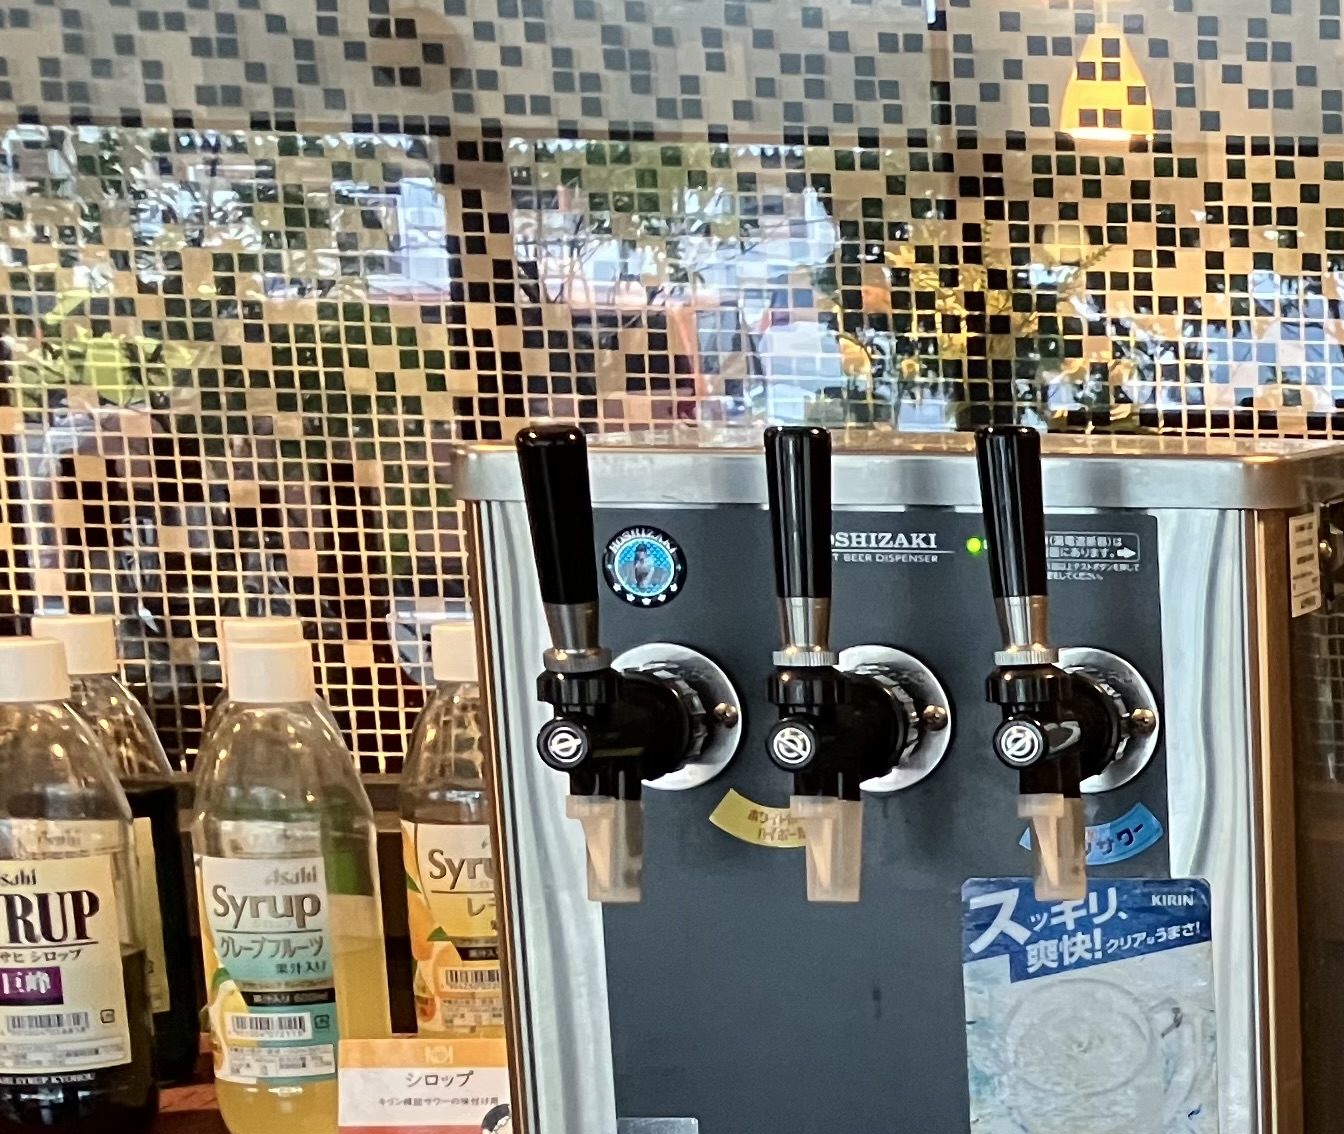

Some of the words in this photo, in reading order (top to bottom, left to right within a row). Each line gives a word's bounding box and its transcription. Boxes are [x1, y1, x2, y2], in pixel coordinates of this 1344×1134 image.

[843, 553, 873, 562] BEER
[875, 553, 938, 563] DISPENSER
[264, 866, 319, 886] Asahi
[212, 884, 322, 930] Syrup
[1151, 894, 1195, 907] KIRIN
[220, 935, 324, 960] グレープフルーツ
[275, 961, 328, 975] 果汁入り
[405, 1069, 475, 1088] シロップ
